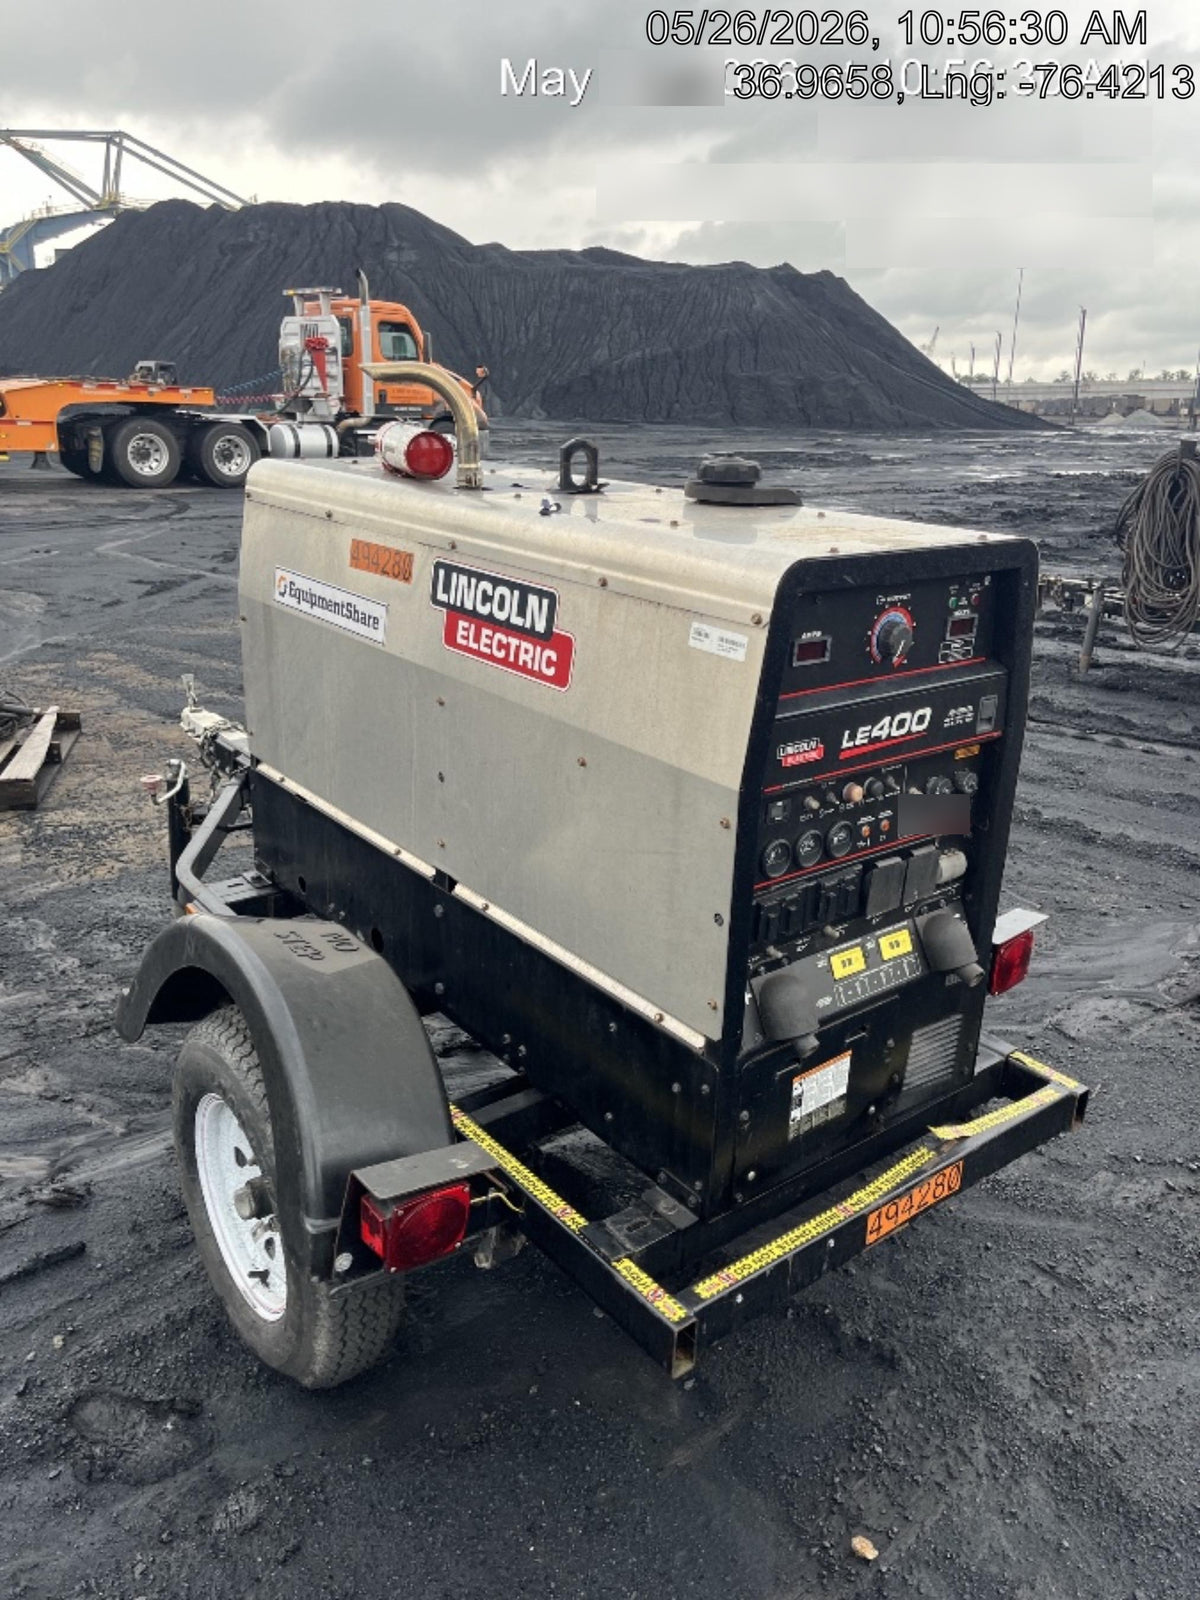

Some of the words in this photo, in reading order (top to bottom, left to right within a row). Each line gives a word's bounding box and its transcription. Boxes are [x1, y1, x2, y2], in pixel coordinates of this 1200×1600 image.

[288, 579, 380, 632] EquipmentShare
[436, 568, 550, 634] LINCOLN
[456, 619, 558, 677] ELECTRIC
[840, 706, 933, 750] LE400
[868, 1163, 960, 1237] 494280
[734, 1263, 753, 1276] DO
[752, 1248, 778, 1265] NOT
[779, 1227, 813, 1250] STAND
